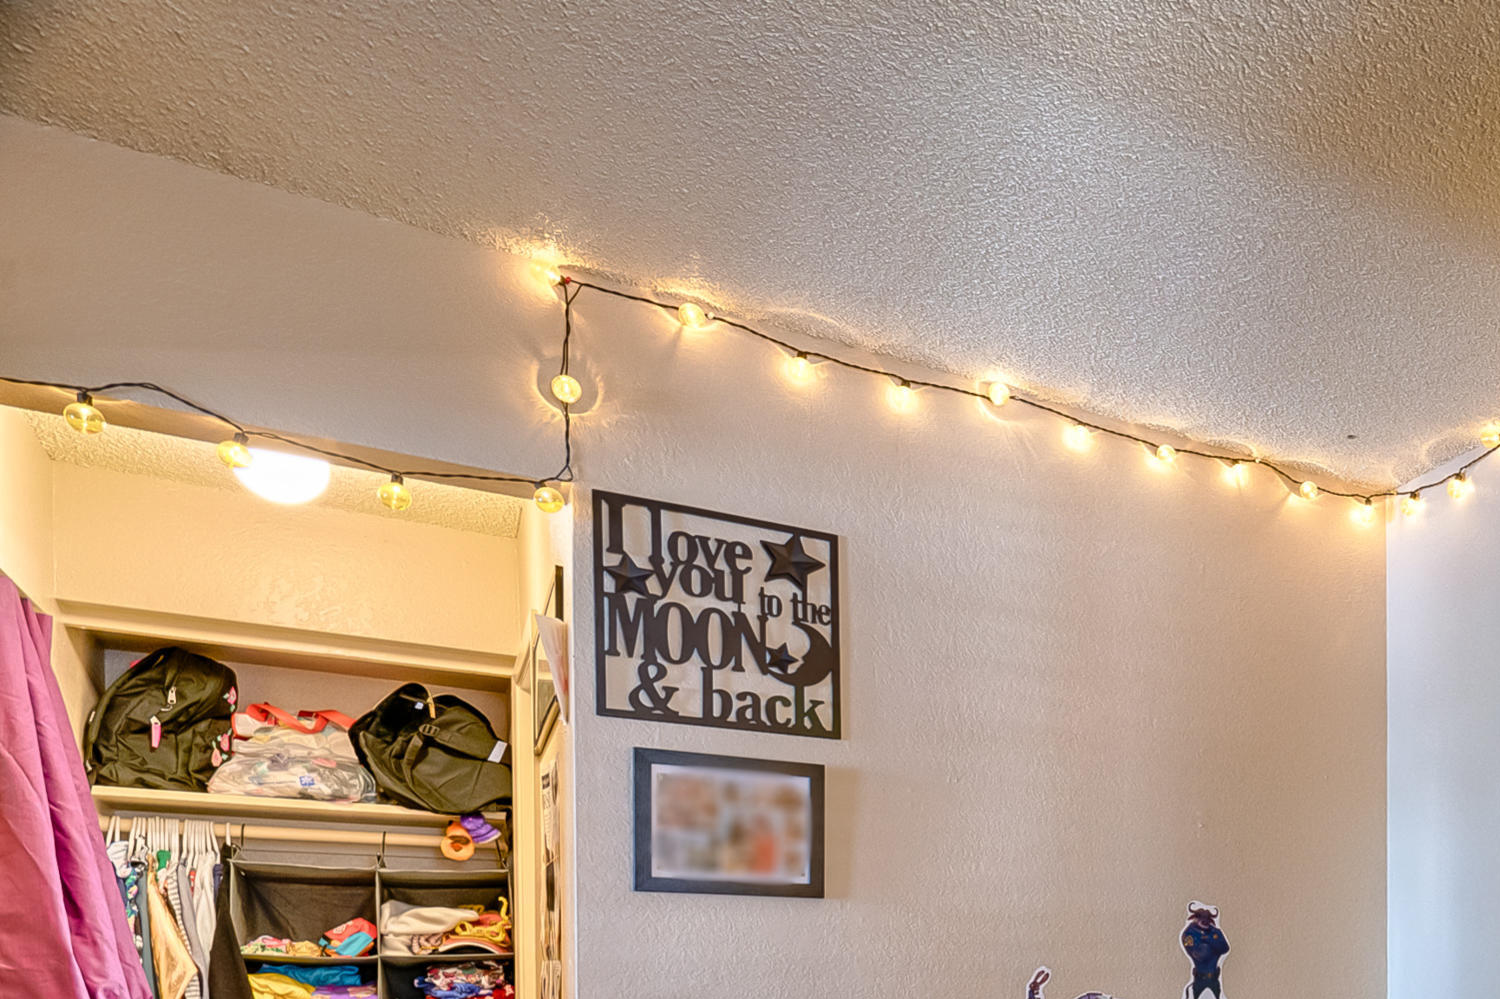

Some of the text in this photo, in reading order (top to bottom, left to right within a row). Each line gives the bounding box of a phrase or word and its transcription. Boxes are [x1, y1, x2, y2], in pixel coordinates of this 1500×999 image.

[604, 500, 754, 575] I love
[645, 560, 747, 605] you
[757, 587, 832, 626] to the
[603, 593, 769, 675] MOON
[627, 660, 830, 732] & back
